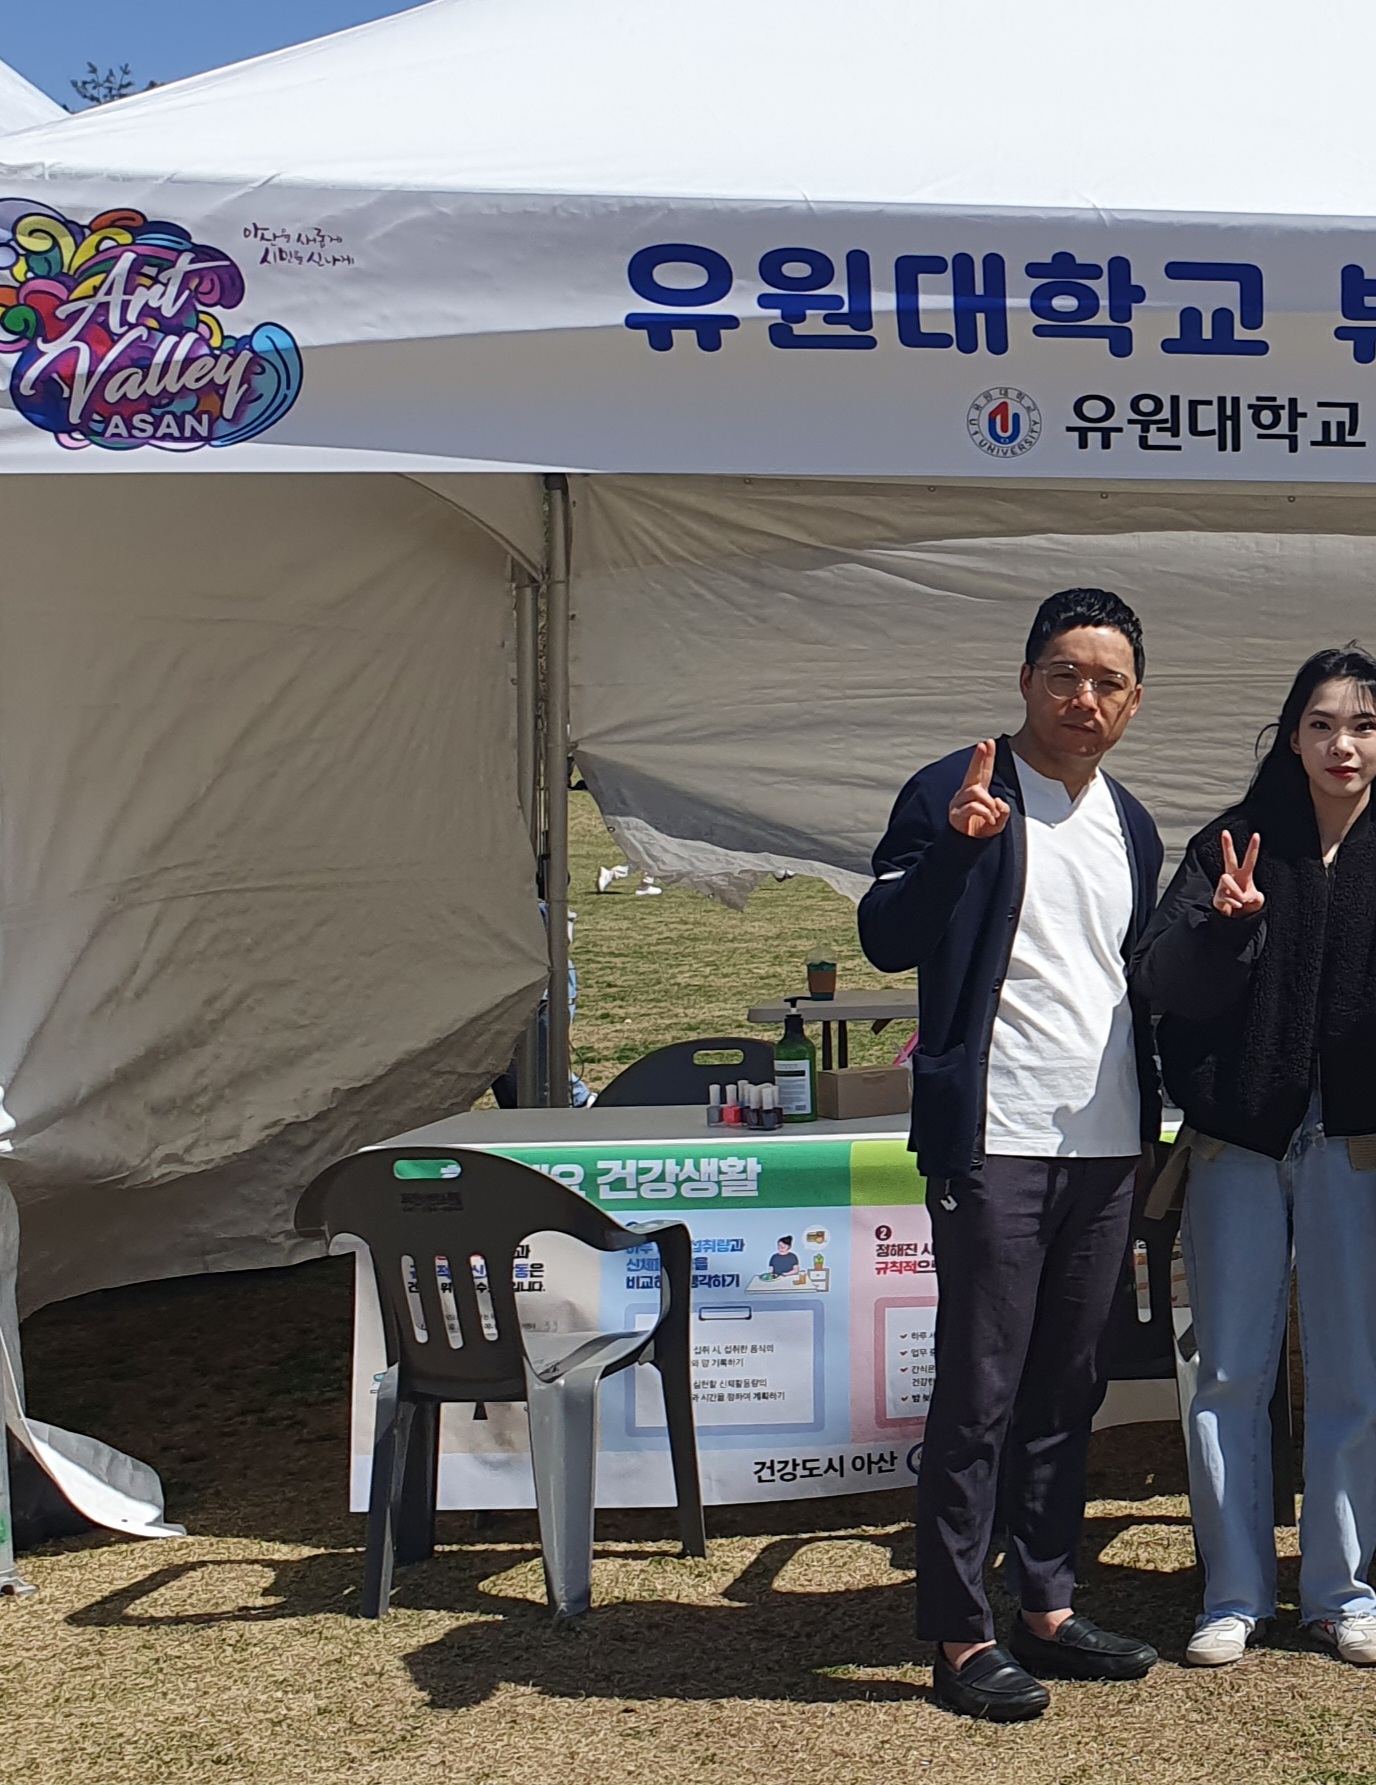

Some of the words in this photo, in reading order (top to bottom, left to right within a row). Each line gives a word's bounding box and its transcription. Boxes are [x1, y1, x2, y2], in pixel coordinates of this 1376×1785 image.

[56, 251, 231, 334] Art
[624, 242, 1270, 358] 유원대학교
[20, 327, 254, 424] Valley
[104, 414, 209, 437] ASAN
[1064, 393, 1367, 454] 유원대학교
[597, 1156, 762, 1200] 건강생활
[875, 1243, 918, 1257] 정해진
[875, 1260, 936, 1275] 규칙적으
[753, 1454, 845, 1484] 건강도시
[851, 1450, 898, 1475] 아산
